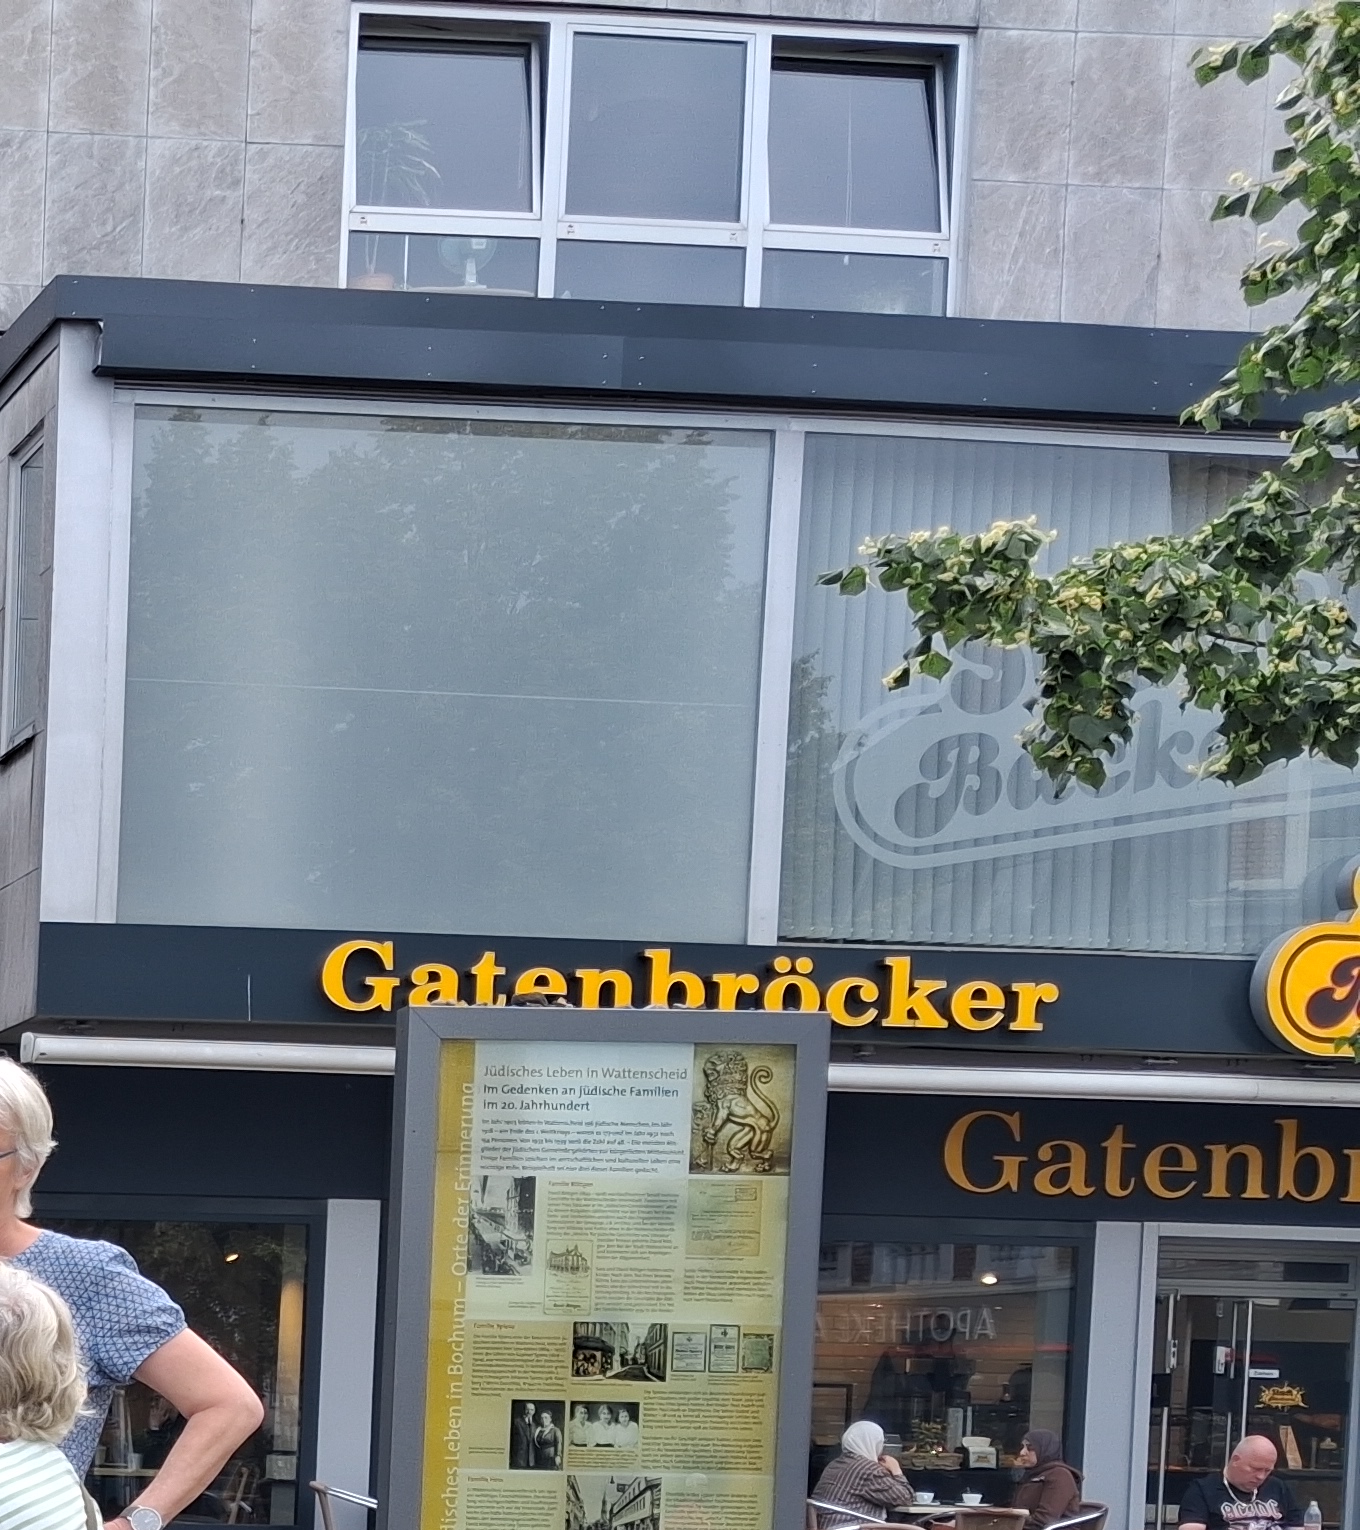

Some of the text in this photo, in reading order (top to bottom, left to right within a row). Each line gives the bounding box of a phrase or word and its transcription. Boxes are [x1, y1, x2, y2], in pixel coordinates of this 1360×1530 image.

[322, 939, 1059, 1032] Gatenbröcker
[483, 1065, 688, 1080] Jüdisches Leben in Wattenscheid
[501, 1084, 559, 1096] Gedenken
[561, 1087, 576, 1096] an
[579, 1085, 627, 1098] jüdische
[629, 1086, 679, 1098] Familien
[501, 1101, 518, 1111] 20.
[519, 1100, 590, 1112] Jahrhundert
[454, 1082, 474, 1191] Erinnerung
[452, 1198, 469, 1228] der
[451, 1239, 468, 1276] Orte
[447, 1298, 466, 1376] Bochum
[445, 1382, 463, 1401] in
[443, 1406, 462, 1460] Leben
